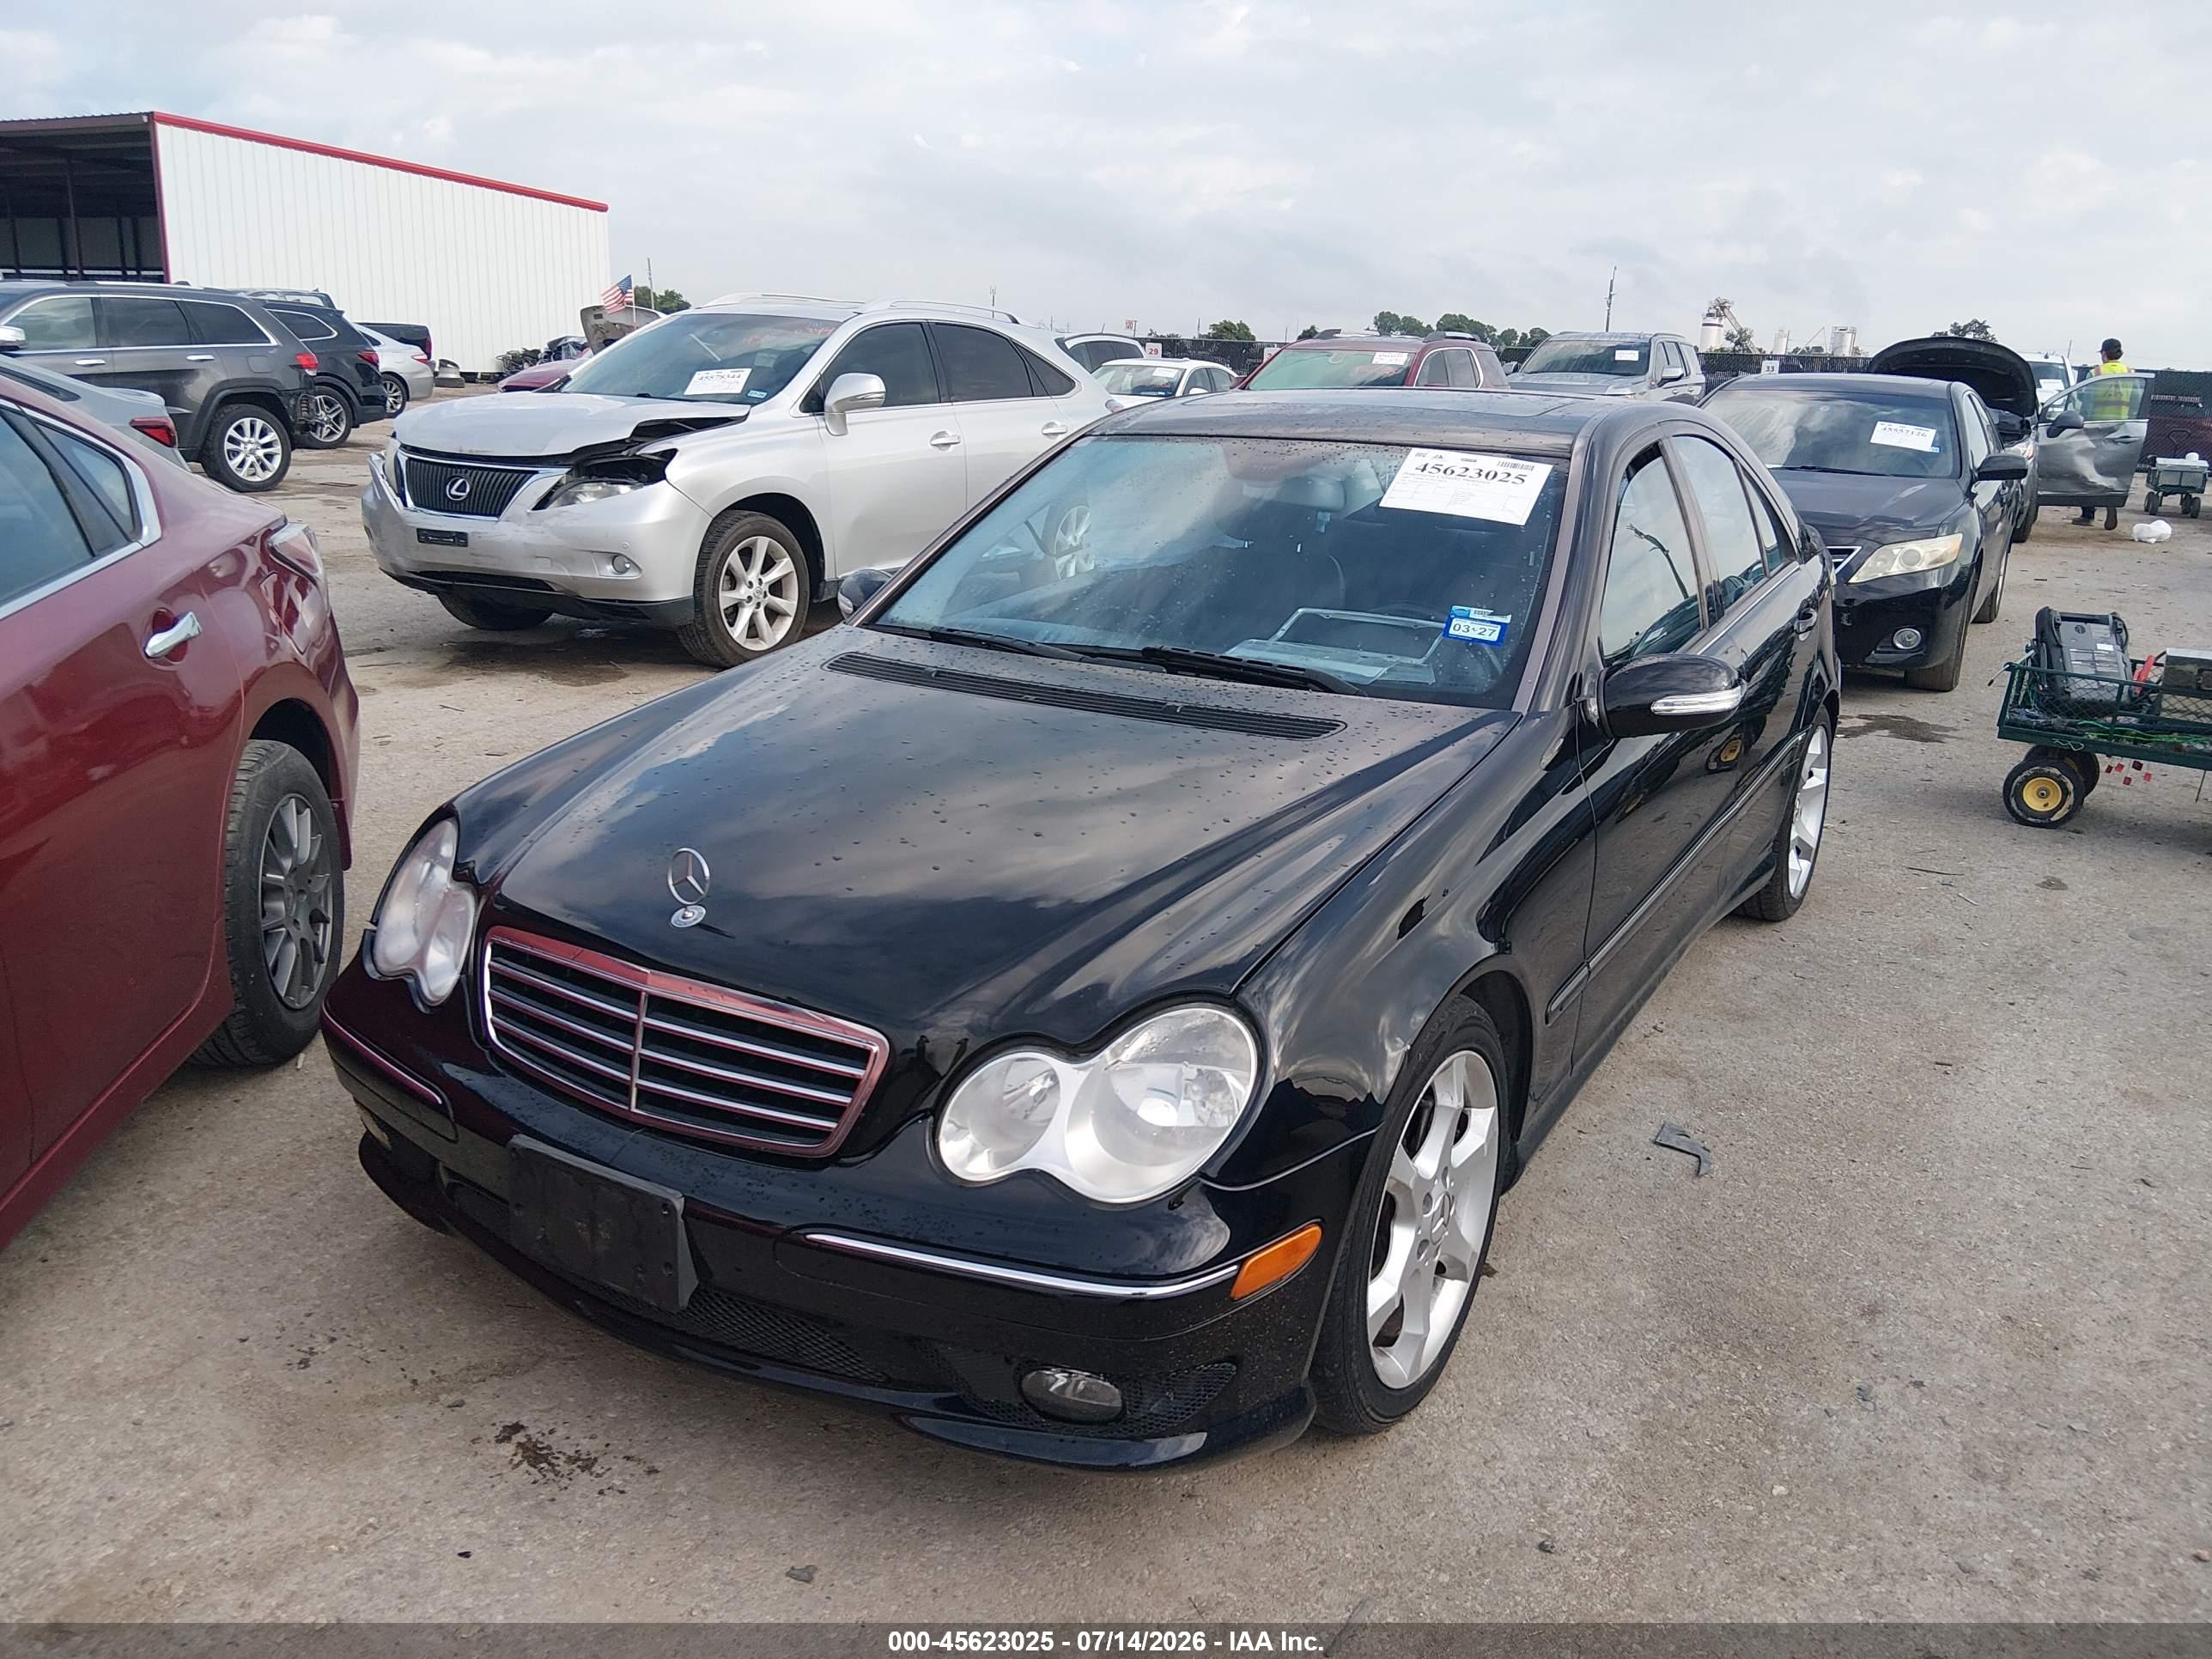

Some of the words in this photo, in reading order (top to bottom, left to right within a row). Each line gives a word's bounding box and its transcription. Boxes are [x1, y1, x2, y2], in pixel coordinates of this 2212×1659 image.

[1414, 462, 1528, 485] 45623025
[1452, 623, 1470, 634] 03
[1476, 627, 1498, 637] 27
